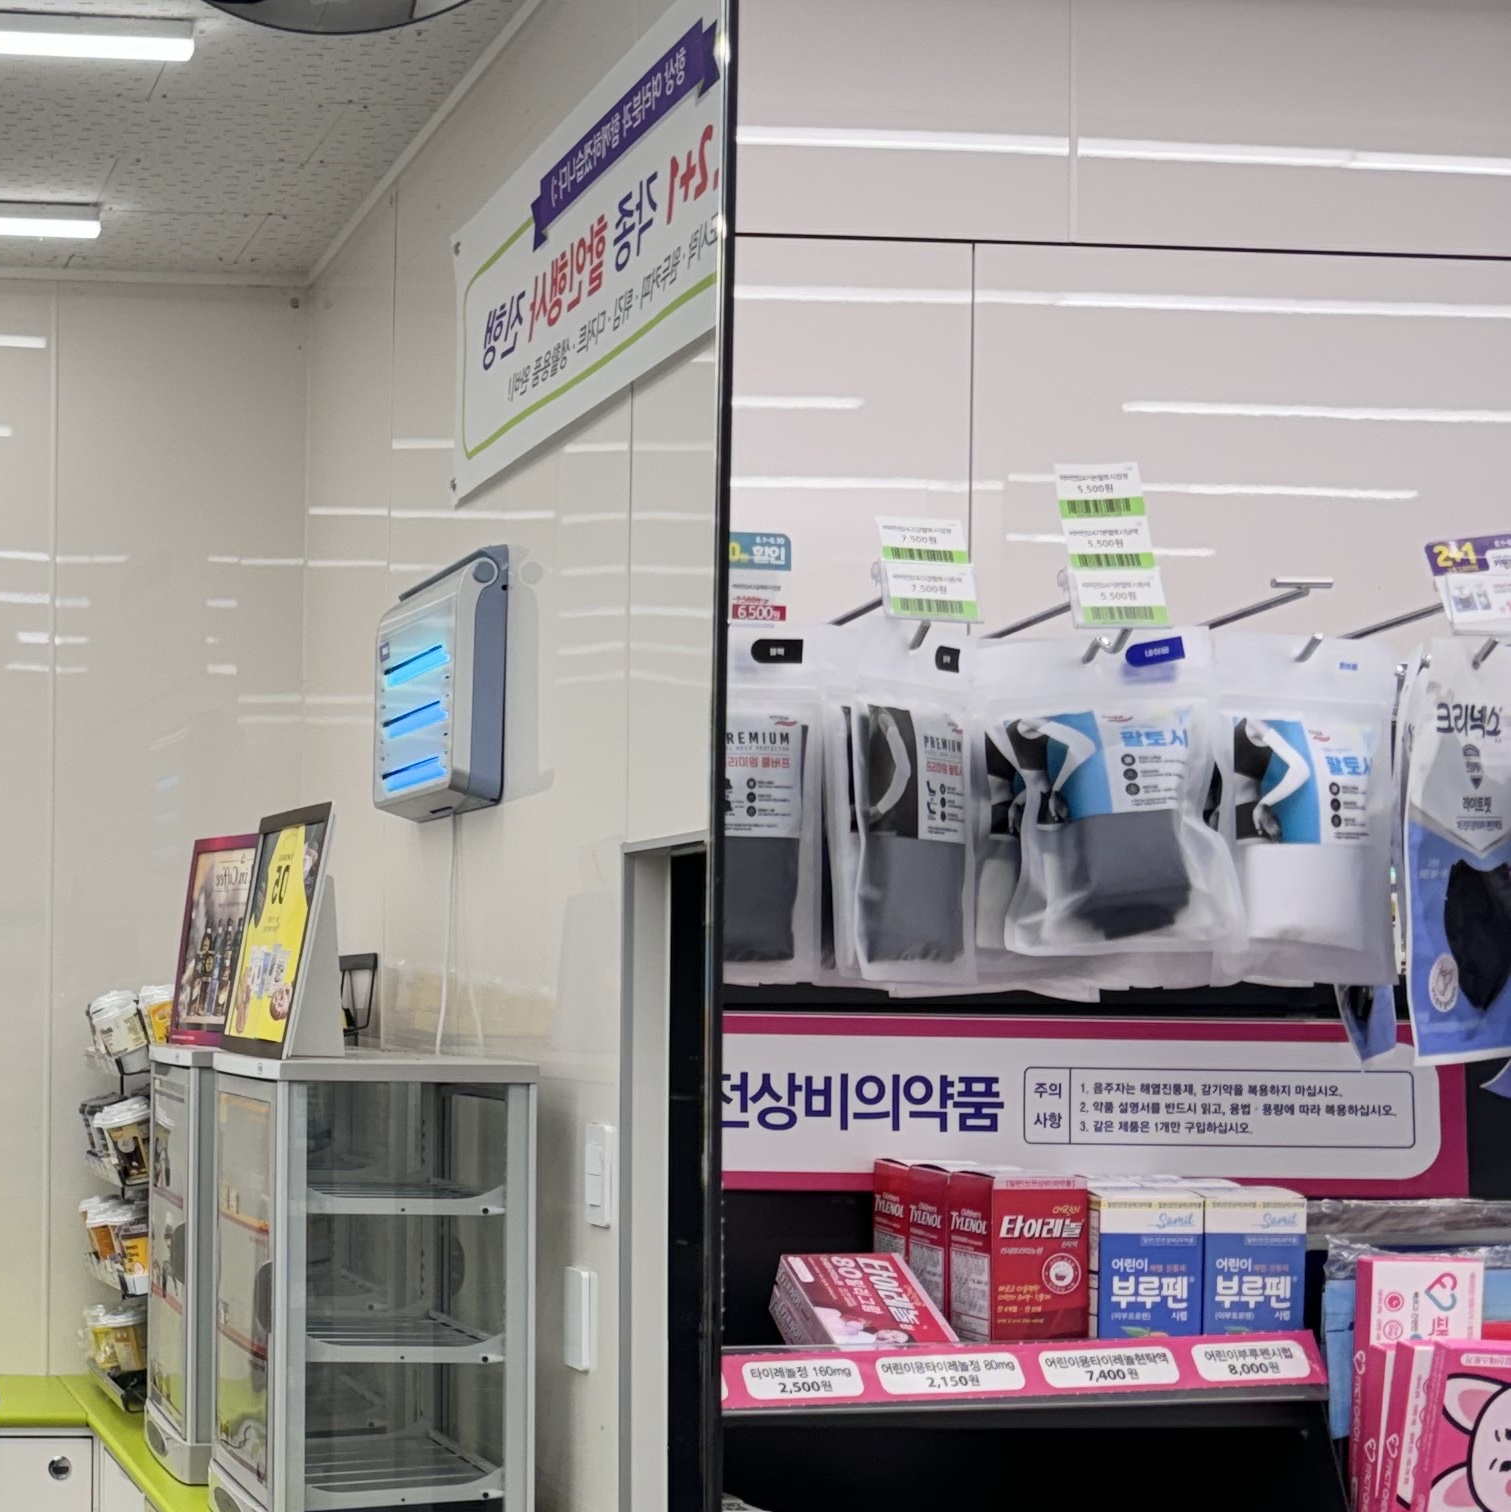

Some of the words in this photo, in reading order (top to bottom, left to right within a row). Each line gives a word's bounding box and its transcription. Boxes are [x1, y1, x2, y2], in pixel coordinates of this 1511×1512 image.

[751, 546, 786, 565] 할인
[1432, 542, 1478, 568] 2+1
[737, 605, 781, 620] 6,500원
[923, 736, 962, 754] PREMIUM
[1034, 1082, 1062, 1099] 주의
[1080, 1084, 1088, 1095] 1.
[1093, 1083, 1135, 1096] 음주자는
[1140, 1083, 1197, 1097] 해열진통제,
[1201, 1083, 1243, 1097] 감기약을
[1248, 1084, 1291, 1097] 복용하지
[1295, 1085, 1343, 1098] 마십시오.
[1080, 1103, 1089, 1113] 2.
[1093, 1102, 1114, 1115] 약품
[1118, 1102, 1160, 1115] 설명서를
[1165, 1103, 1196, 1116] 반드시
[1201, 1103, 1225, 1117] 읽고,
[1229, 1104, 1250, 1116] 용법
[1262, 1104, 1295, 1117] 용량에
[1299, 1104, 1320, 1117] 따라
[1325, 1104, 1397, 1118] 복용하십시오.
[1034, 1113, 1062, 1129] 사항
[1080, 1122, 1088, 1132] 3.
[1093, 1121, 1114, 1133] 같은
[1118, 1122, 1150, 1134] 제품은
[1154, 1122, 1180, 1134] 1개만
[1185, 1122, 1254, 1135] 구입하십시오.
[874, 1193, 904, 1218] TYLENOL
[909, 1203, 942, 1229] TYLENOL
[950, 1210, 987, 1235] TYLENOL
[999, 1215, 1085, 1239] 타이레놀
[1111, 1257, 1148, 1273] 어린이
[1215, 1257, 1252, 1273] 어린이
[855, 1256, 921, 1327] 타이레놀
[1110, 1276, 1188, 1309] 부루펜
[1214, 1276, 1292, 1309] 부루펜
[1171, 1310, 1187, 1321] 시럽
[1274, 1310, 1291, 1321] 시럽
[1044, 1352, 1169, 1369] 어린이용타이레놀현탁액
[1204, 1347, 1294, 1362] 어린이부루펜시럽
[750, 1367, 809, 1379] 타이레놀정
[812, 1366, 852, 1379] 160mg
[881, 1361, 981, 1375] 어린이용타이레놀정
[983, 1360, 1015, 1372] 80mg
[1086, 1368, 1139, 1381] 7,400원
[1227, 1362, 1281, 1376] 8,000원
[778, 1380, 833, 1394] 2,500원
[927, 1376, 981, 1389] 2,150원
